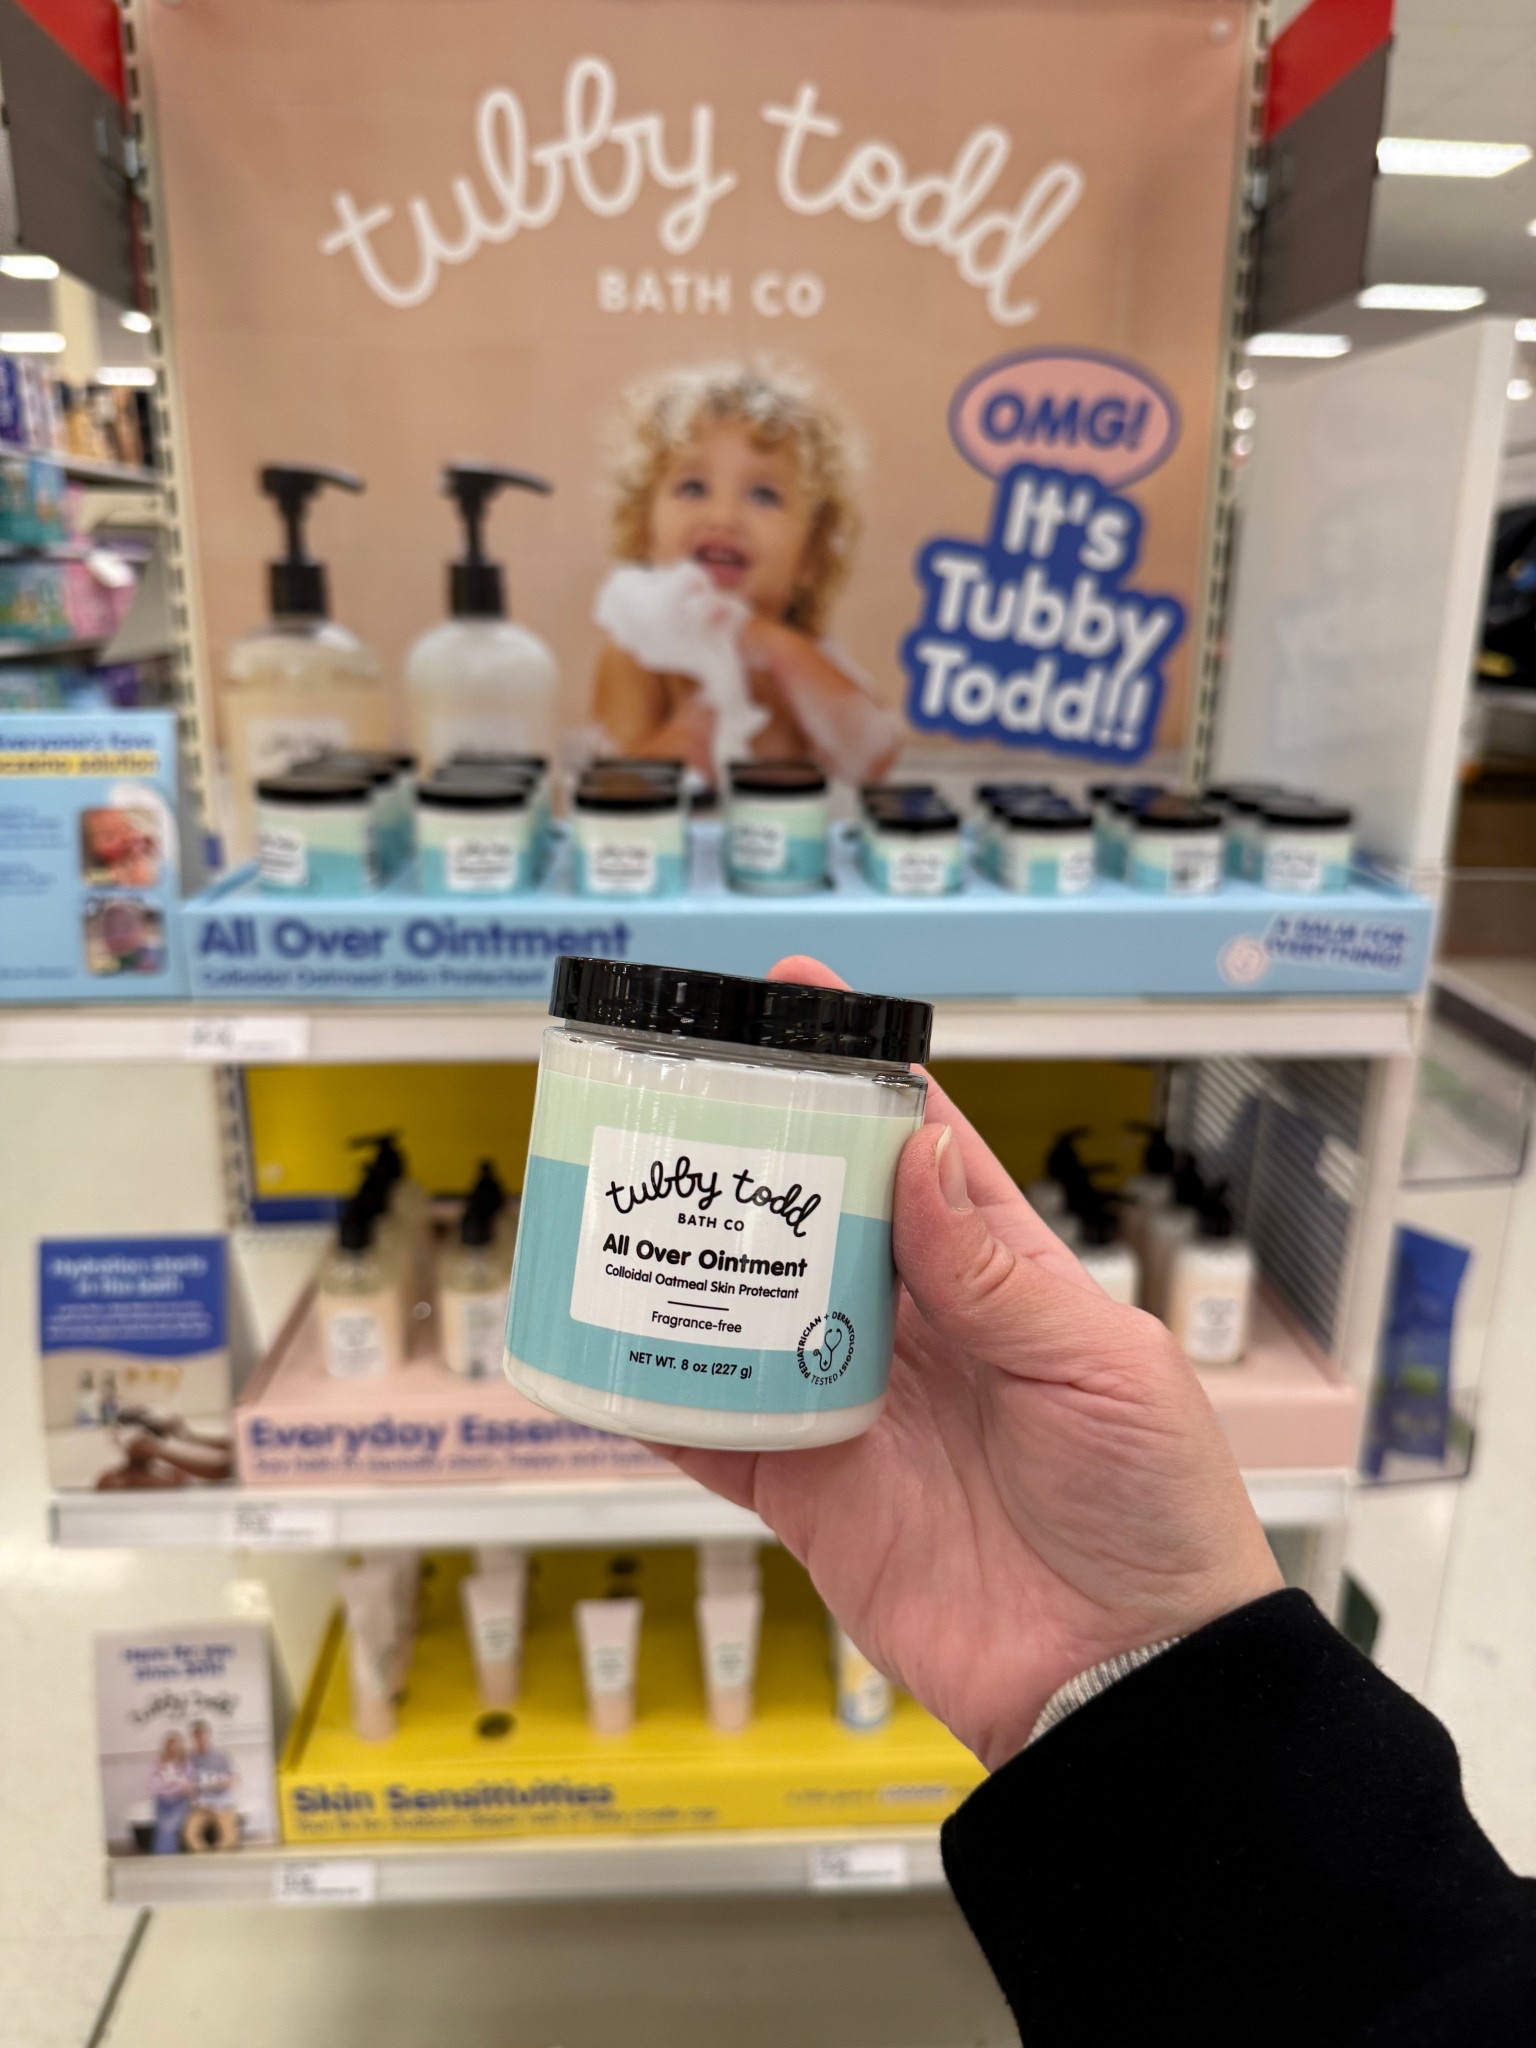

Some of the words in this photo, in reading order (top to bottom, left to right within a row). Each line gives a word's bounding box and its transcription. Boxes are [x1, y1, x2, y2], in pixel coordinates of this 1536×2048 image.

[320, 56, 738, 307] tubby
[761, 84, 1085, 325] todd
[598, 268, 733, 315] BATH
[752, 269, 826, 317] CO
[980, 390, 1150, 452] OMG!
[1002, 475, 1130, 571] It's
[930, 556, 1170, 680] Tubby
[914, 642, 1150, 750] Todd!!
[198, 916, 257, 958] All
[271, 917, 390, 959] Over
[404, 915, 631, 958] Ointment
[605, 1156, 722, 1213] tubby
[732, 1169, 821, 1237] todd
[677, 1212, 717, 1229] BATH
[723, 1218, 745, 1232] CO
[603, 1233, 630, 1256] All
[636, 1239, 692, 1266] Over
[698, 1249, 808, 1278] Ointment
[605, 1263, 652, 1283] Colloidal
[655, 1273, 708, 1291] Oatmeal
[710, 1280, 735, 1295] Skin
[738, 1284, 799, 1299] Protectant
[651, 1310, 742, 1333] Fragrance-free
[831, 1310, 856, 1377] DERMATOLOGIST
[629, 1350, 652, 1365] NET
[656, 1355, 676, 1369] WT.
[680, 1358, 689, 1371] 8
[693, 1362, 708, 1373] oz
[711, 1361, 737, 1375] (227
[740, 1365, 752, 1379] g)
[796, 1315, 823, 1379] PEDIATRICIAN
[810, 1372, 838, 1386] TESTED
[249, 1415, 446, 1456] Everyday
[292, 1784, 376, 1813] Skin
[386, 1778, 618, 1810] Sensitivities
